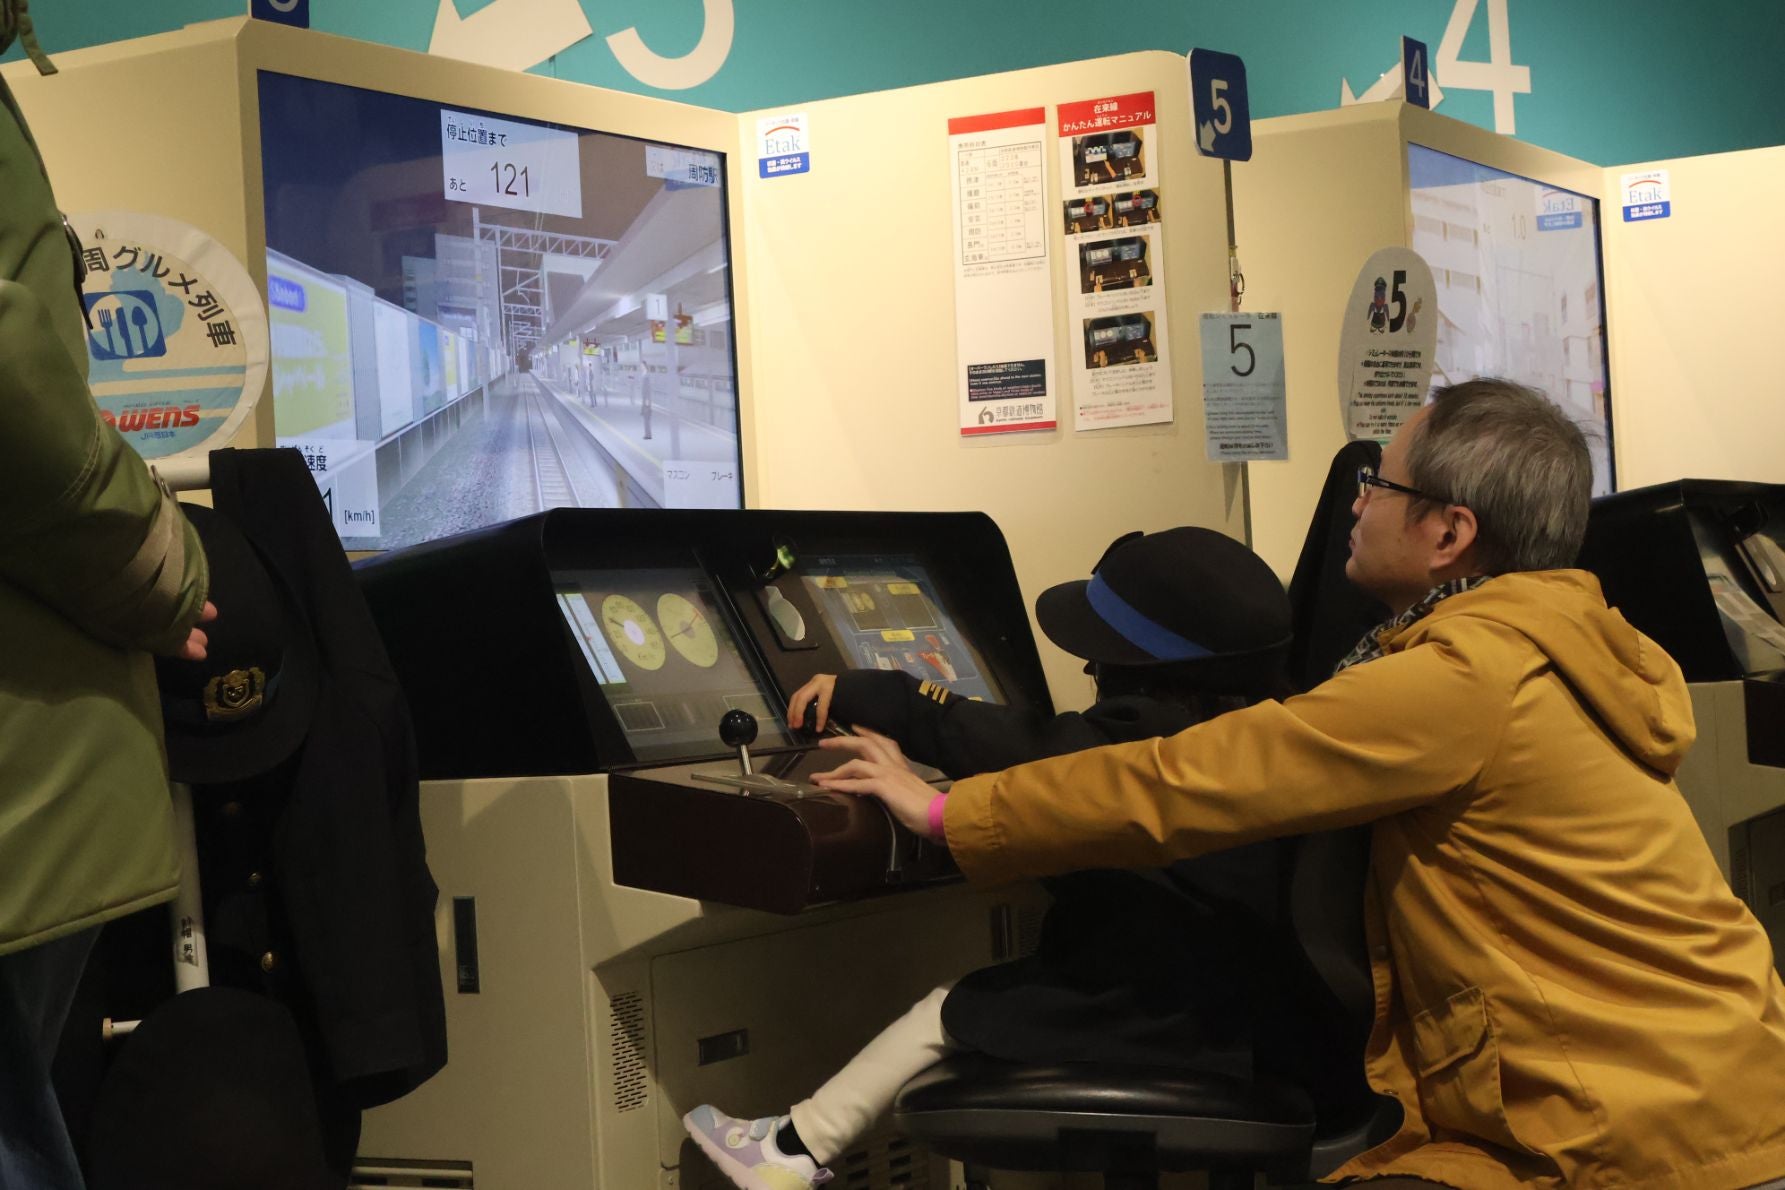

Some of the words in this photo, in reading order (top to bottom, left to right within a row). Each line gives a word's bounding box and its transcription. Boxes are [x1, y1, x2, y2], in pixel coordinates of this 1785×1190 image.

[1409, 49, 1425, 98] 4
[1436, 0, 1532, 135] 4
[1063, 111, 1152, 132] かんたん運転マニュアル
[1211, 78, 1232, 135] 5
[447, 123, 507, 148] 停止位置まで
[765, 135, 801, 155] Etak
[449, 177, 467, 192] あと
[490, 161, 530, 198] 121
[1629, 187, 1662, 204] Etak
[1389, 270, 1407, 333] 5
[1229, 323, 1256, 377] 5
[344, 509, 375, 525] [km/h]
